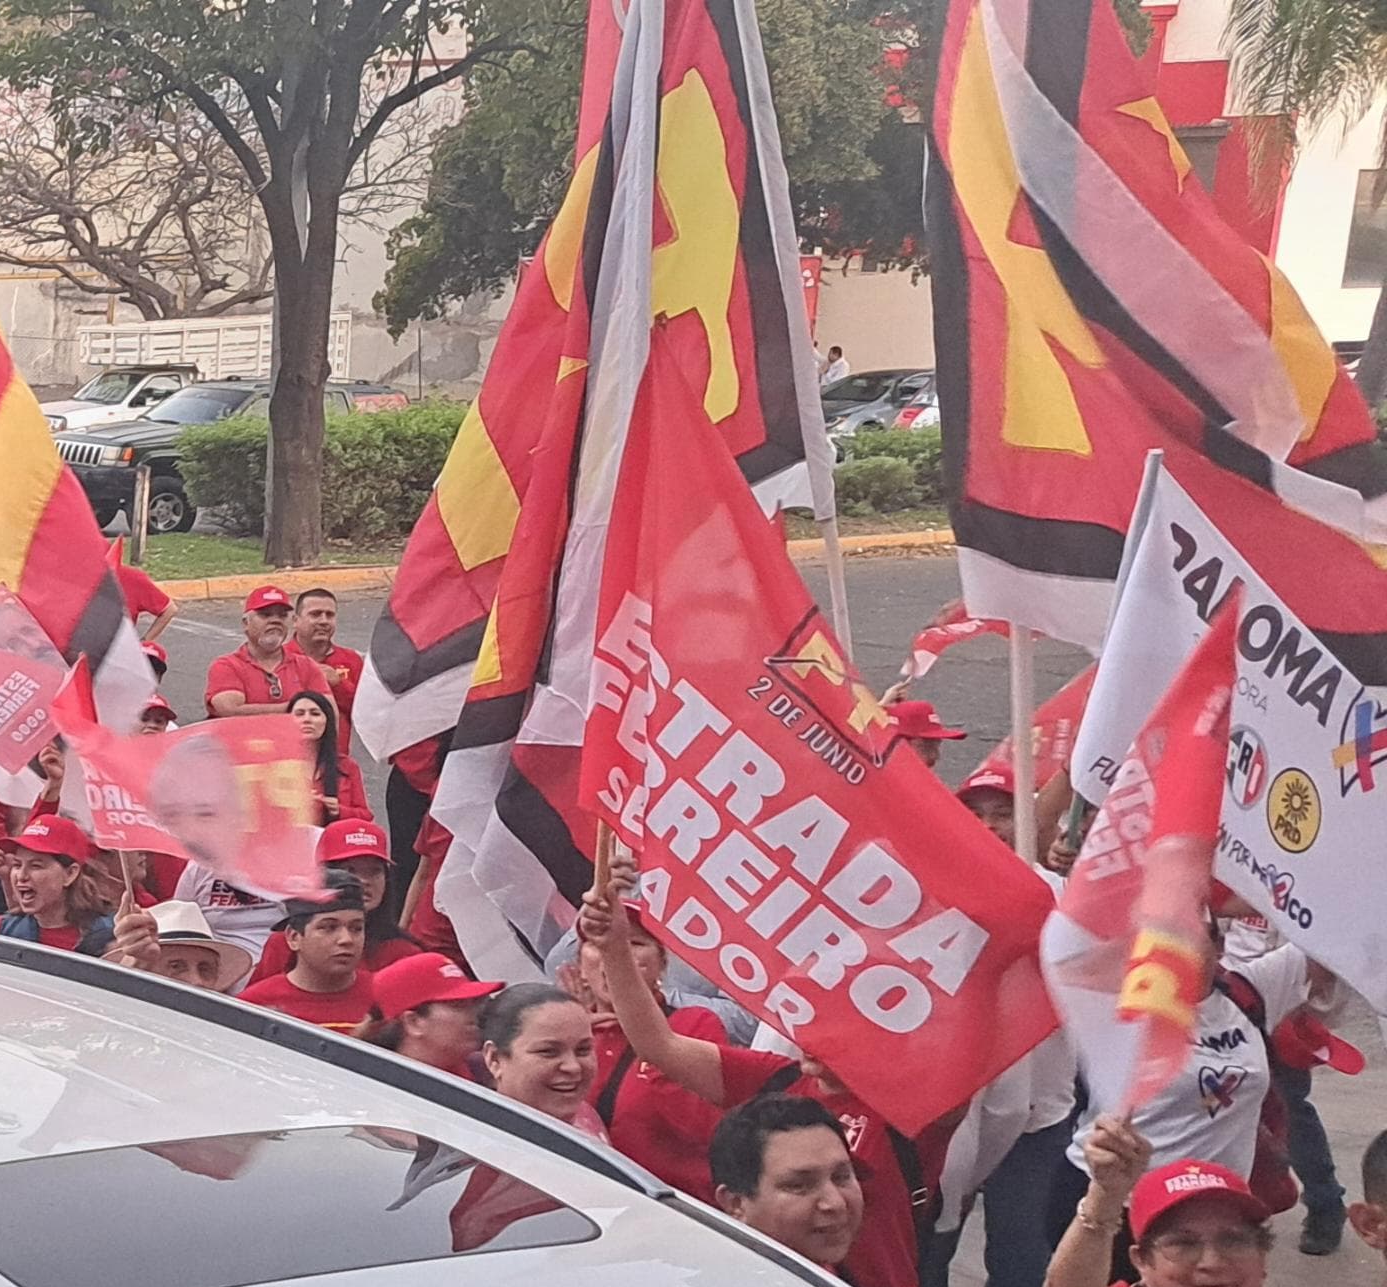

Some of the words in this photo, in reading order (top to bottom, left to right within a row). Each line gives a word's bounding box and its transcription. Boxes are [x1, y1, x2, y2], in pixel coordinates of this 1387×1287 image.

[746, 675, 772, 701] 2
[767, 692, 805, 729] DE
[799, 721, 868, 787] JUNIO
[1274, 814, 1302, 845] PRD
